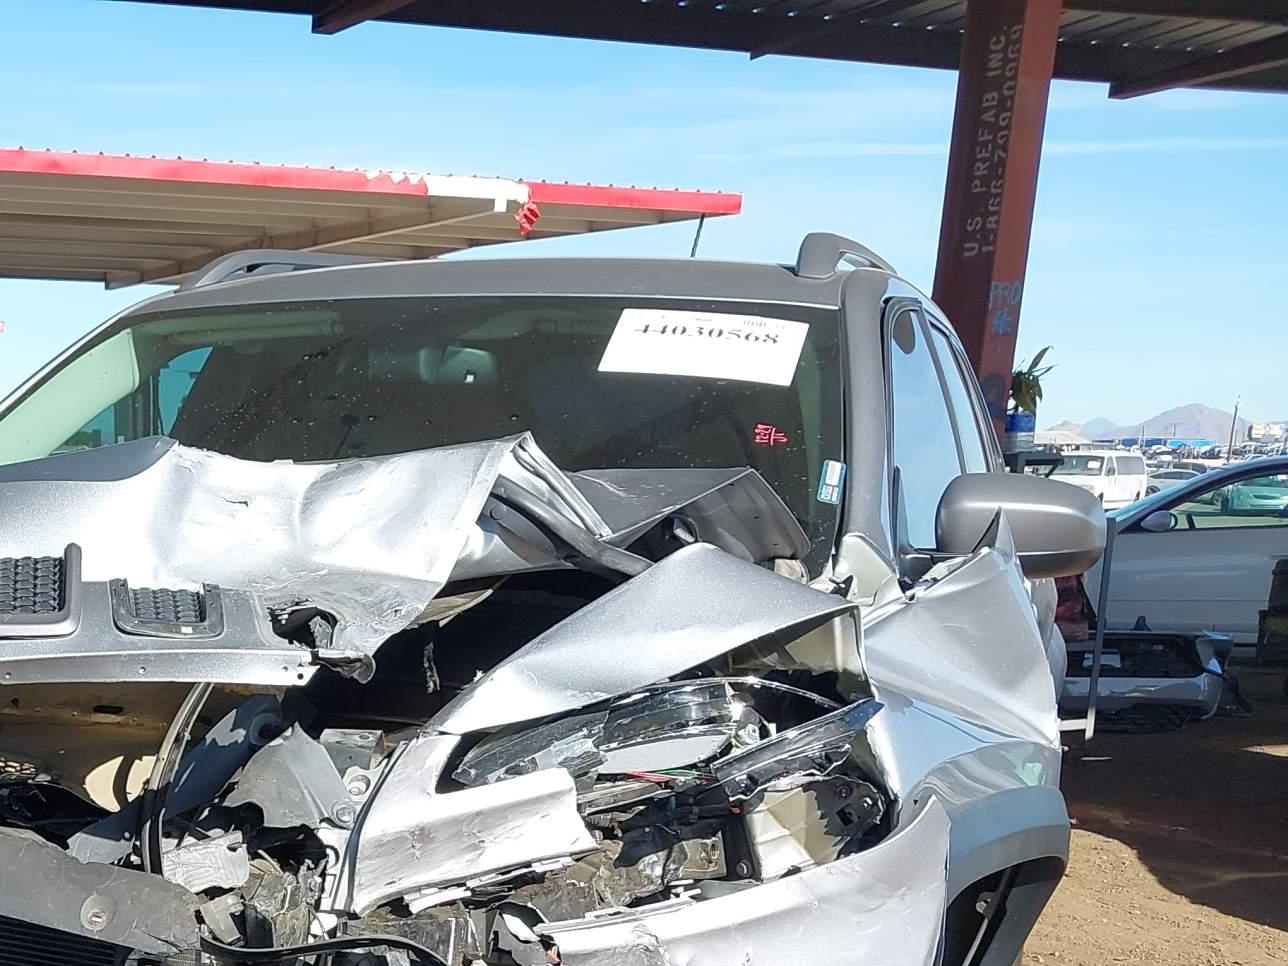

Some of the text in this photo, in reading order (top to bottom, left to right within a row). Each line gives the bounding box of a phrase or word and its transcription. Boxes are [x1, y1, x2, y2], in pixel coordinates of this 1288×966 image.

[985, 25, 1008, 77] INC.
[972, 91, 999, 193] PREFAB
[634, 323, 780, 345] 44030568
